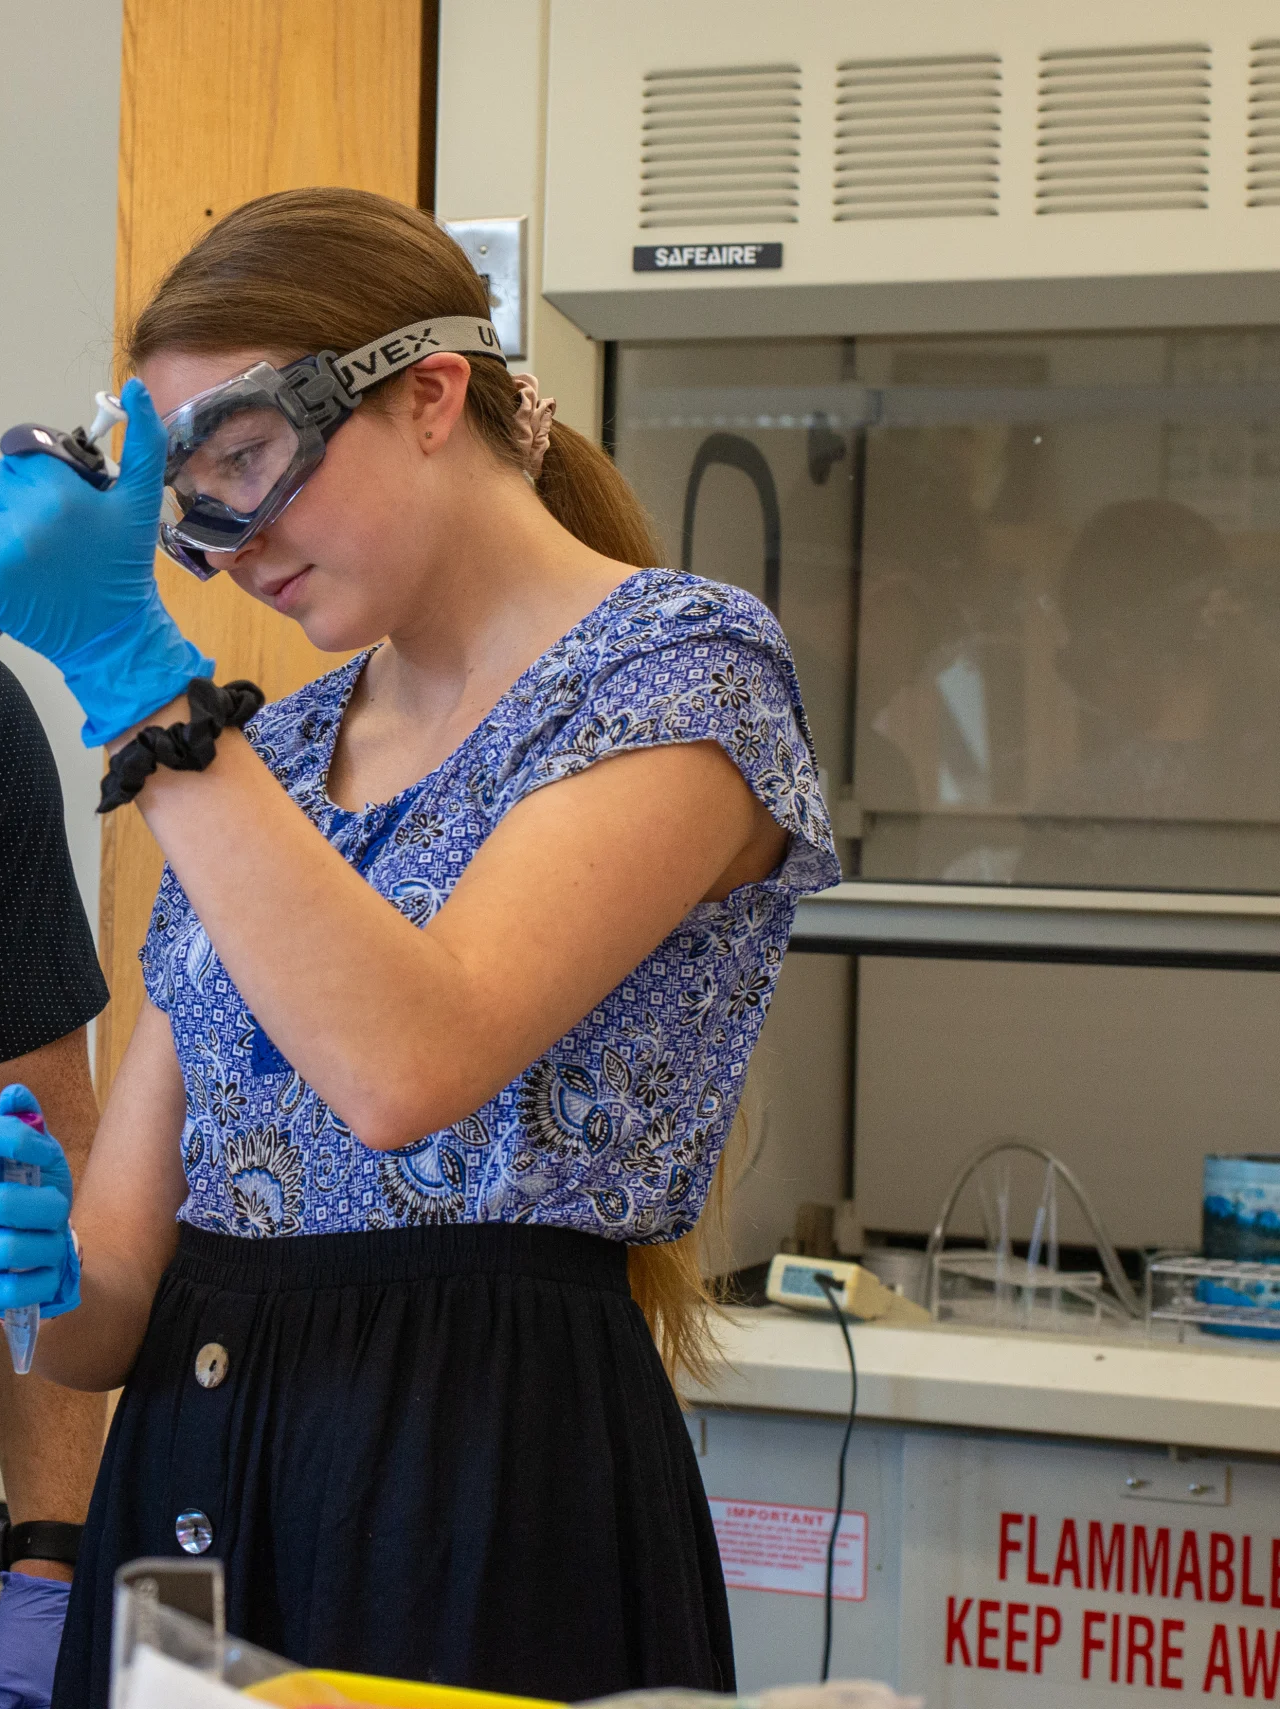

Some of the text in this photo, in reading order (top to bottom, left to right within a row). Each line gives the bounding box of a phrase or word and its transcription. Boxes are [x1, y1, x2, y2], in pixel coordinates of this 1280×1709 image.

[655, 245, 758, 267] SAFEAIRE
[725, 1507, 824, 1526] IMPORTANT
[945, 1596, 1061, 1675] KEEP
[1081, 1610, 1185, 1690] FIRE
